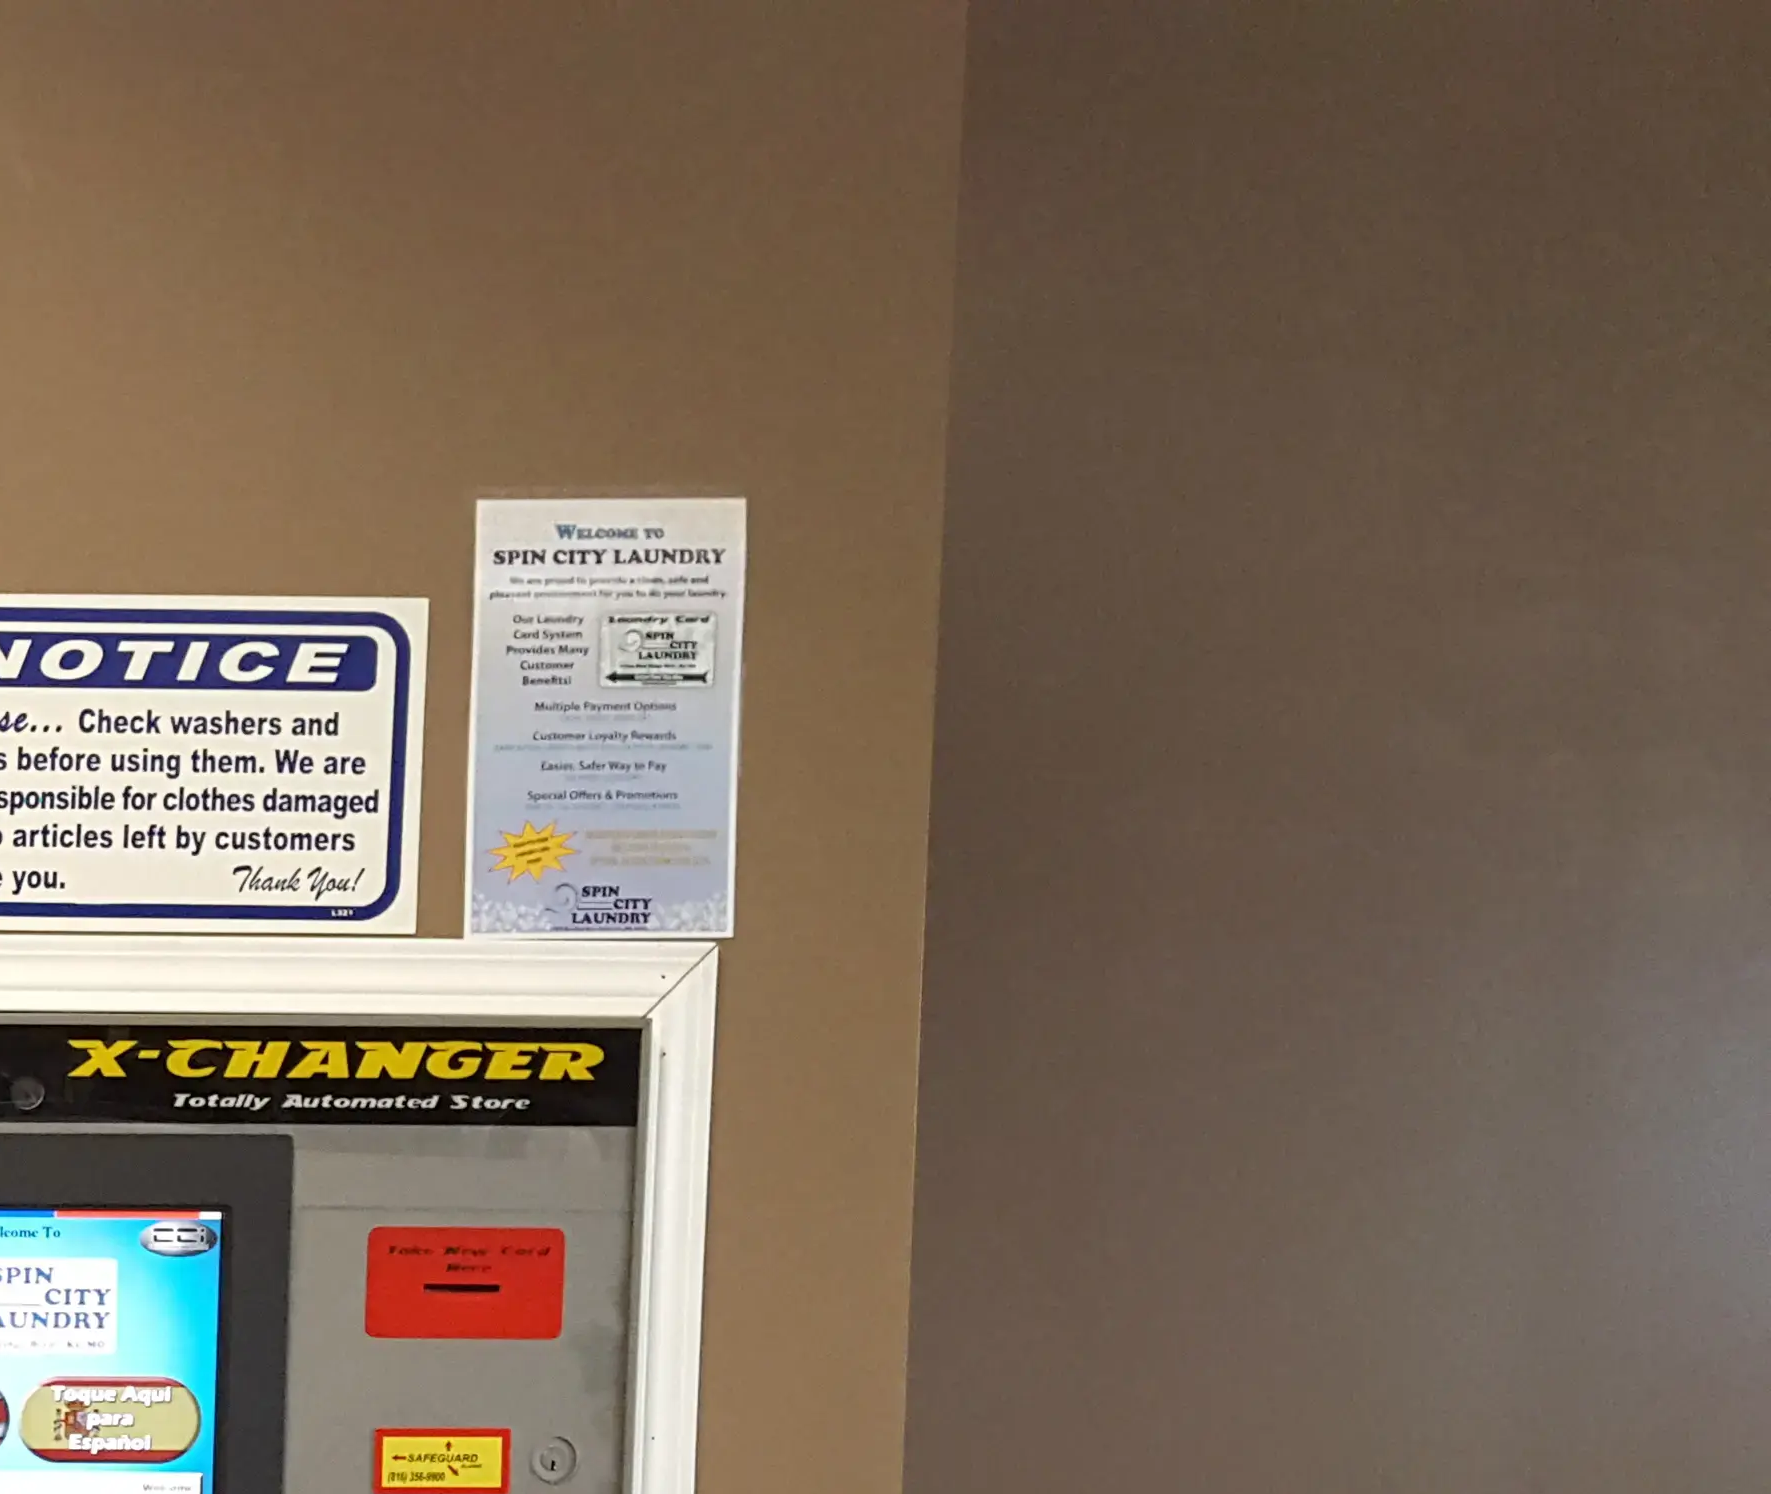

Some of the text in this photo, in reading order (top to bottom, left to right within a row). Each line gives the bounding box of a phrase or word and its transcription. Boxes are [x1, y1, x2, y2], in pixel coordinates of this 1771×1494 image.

[493, 549, 726, 565] SPIN CITY LAUNDRY
[78, 708, 160, 735] Check
[170, 710, 282, 736] washers
[291, 712, 340, 737] and
[17, 747, 101, 772] before
[110, 749, 180, 779] using
[190, 750, 265, 774] them.
[275, 750, 314, 774] We
[323, 756, 366, 774] are
[122, 786, 157, 810] for
[163, 788, 256, 811] clothes
[262, 788, 379, 818] damaged
[13, 824, 113, 849] articles
[122, 825, 167, 850] left
[175, 826, 206, 856] by
[214, 830, 355, 852] customers
[12, 870, 66, 894] you.
[232, 865, 365, 902] Thank You!
[66, 1039, 605, 1081] X-CHANGER
[173, 1093, 530, 1112] Totally Automated Store
[42, 1226, 61, 1239] To
[44, 1288, 111, 1305] CITY
[51, 1386, 117, 1404] Toque
[87, 1411, 133, 1430] para
[68, 1434, 151, 1454] Español
